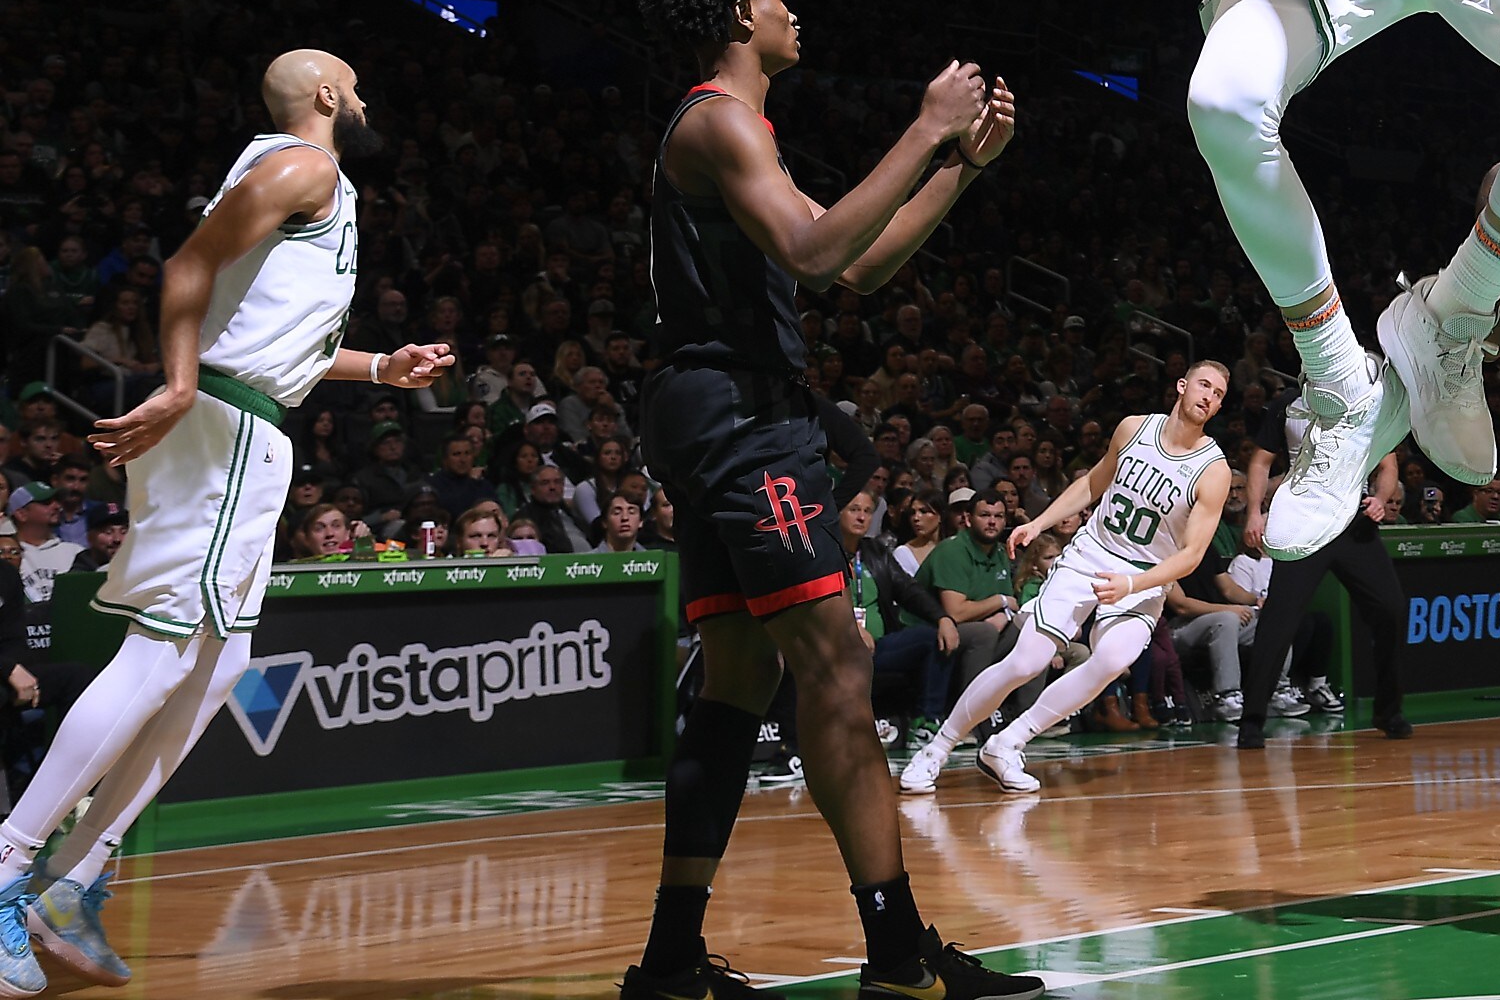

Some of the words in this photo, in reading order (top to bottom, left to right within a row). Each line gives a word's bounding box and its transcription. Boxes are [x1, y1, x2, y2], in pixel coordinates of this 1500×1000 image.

[1114, 456, 1182, 516] CELTICS
[1103, 492, 1162, 546] 30
[446, 566, 487, 583] xfinity
[507, 564, 546, 581] xfinity
[565, 562, 604, 578] xfinity
[622, 559, 660, 576] xfinity
[317, 571, 362, 588] xfinity
[383, 568, 425, 586] xfinity
[314, 628, 604, 713] vistaprint
